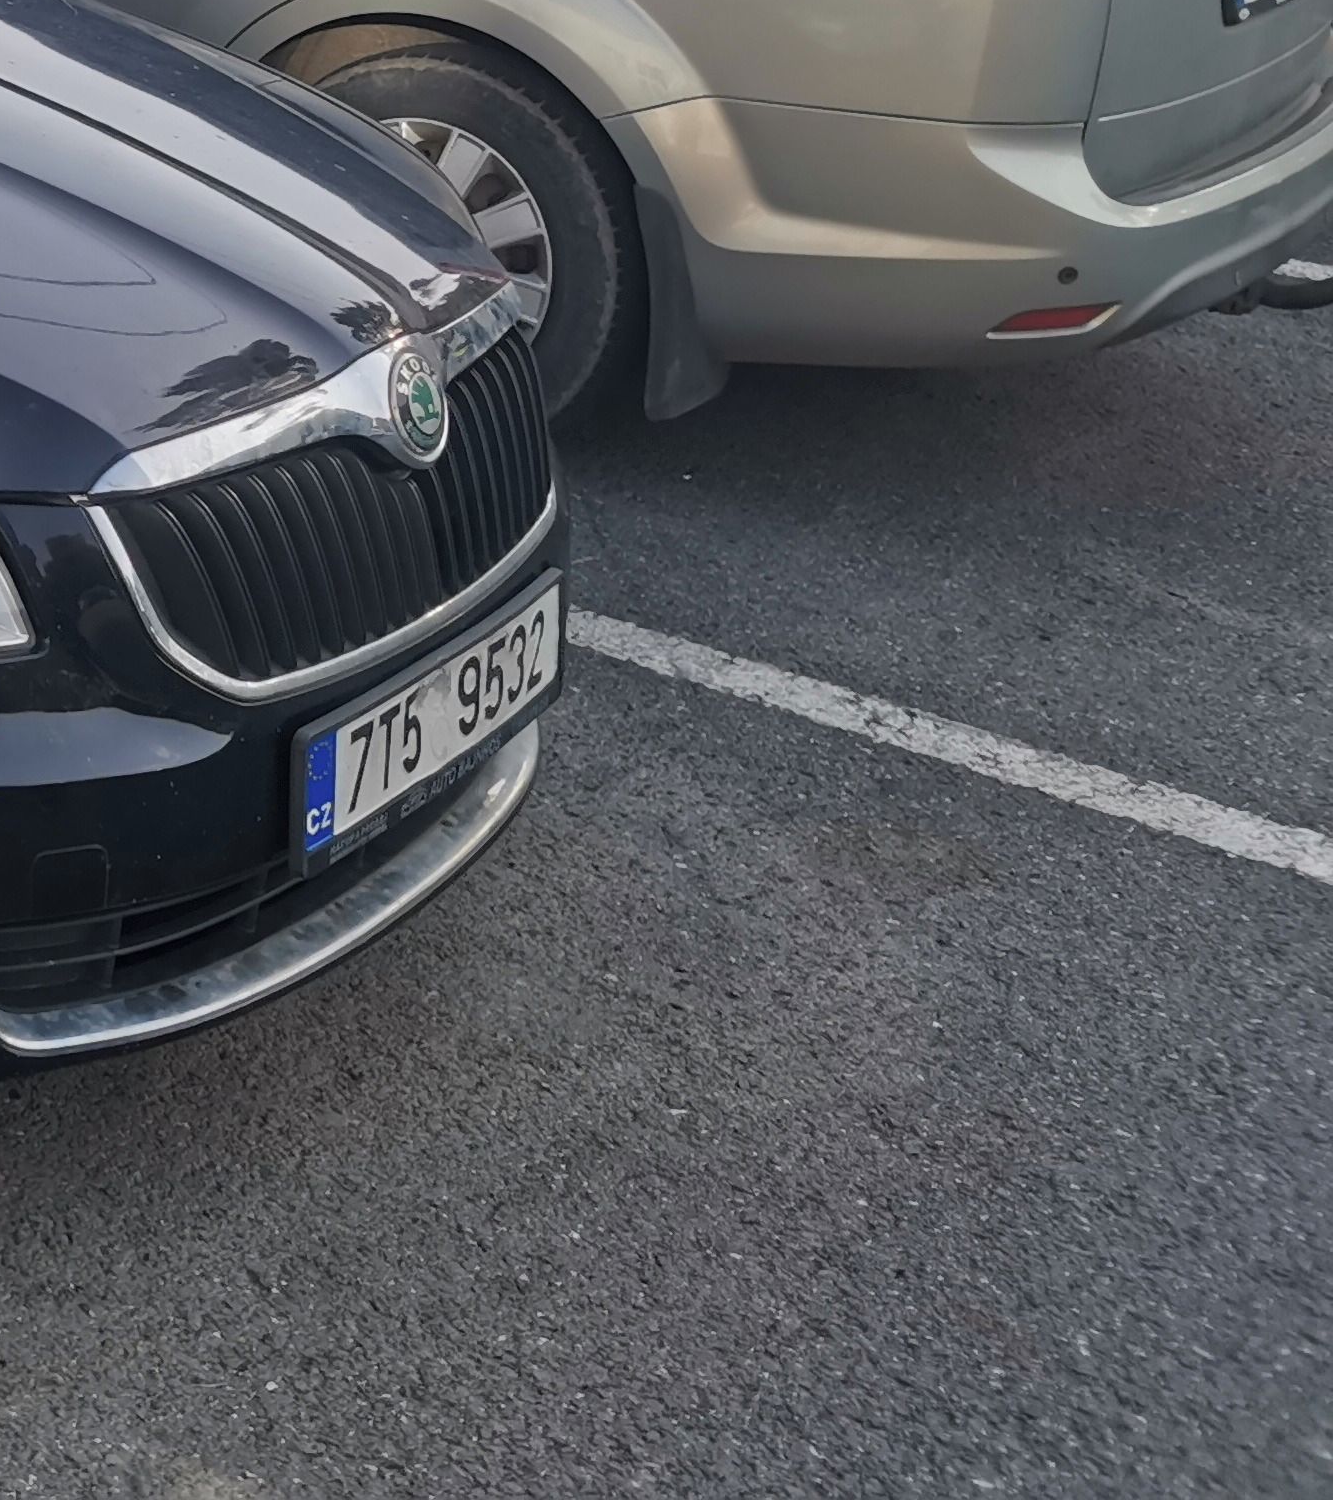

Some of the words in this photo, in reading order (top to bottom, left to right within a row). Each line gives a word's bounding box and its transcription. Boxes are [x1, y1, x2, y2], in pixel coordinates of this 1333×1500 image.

[347, 689, 422, 815] 7T5
[458, 609, 545, 737] 9532
[306, 801, 332, 835] CZ
